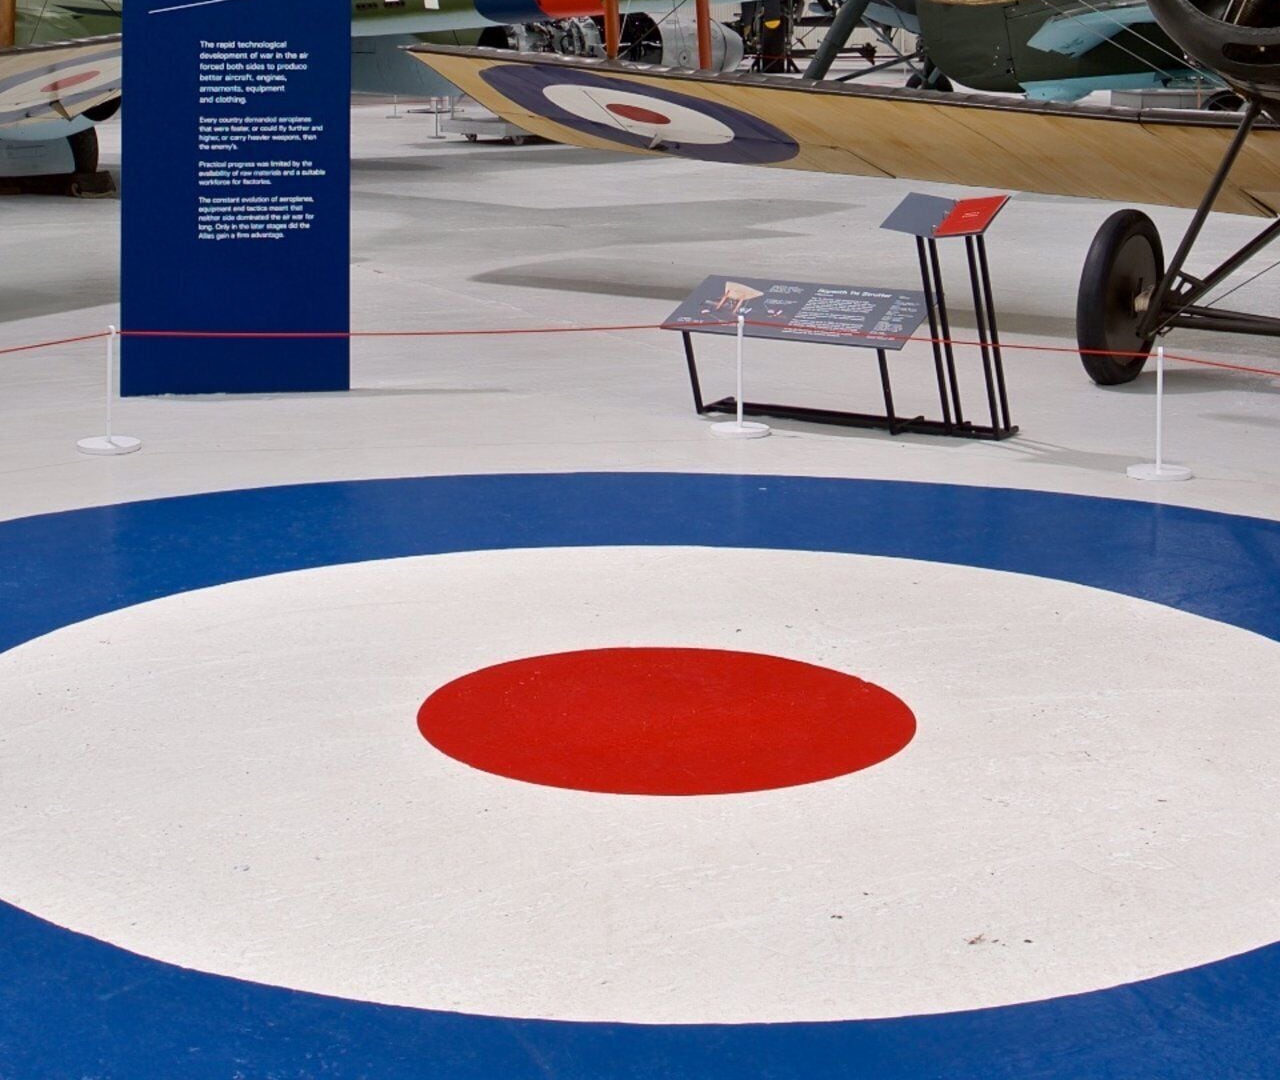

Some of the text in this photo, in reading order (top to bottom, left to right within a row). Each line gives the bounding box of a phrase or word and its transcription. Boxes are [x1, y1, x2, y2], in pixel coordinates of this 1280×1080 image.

[200, 40, 287, 50] The rapid technological
[199, 52, 248, 61] development
[250, 52, 258, 60] of
[276, 52, 283, 60] in
[285, 51, 298, 60] the
[299, 52, 308, 60] air
[200, 62, 308, 72] forced both sides to produce
[199, 73, 287, 83] better aircraft, engines,
[246, 85, 285, 94] equipment
[200, 96, 214, 104] and
